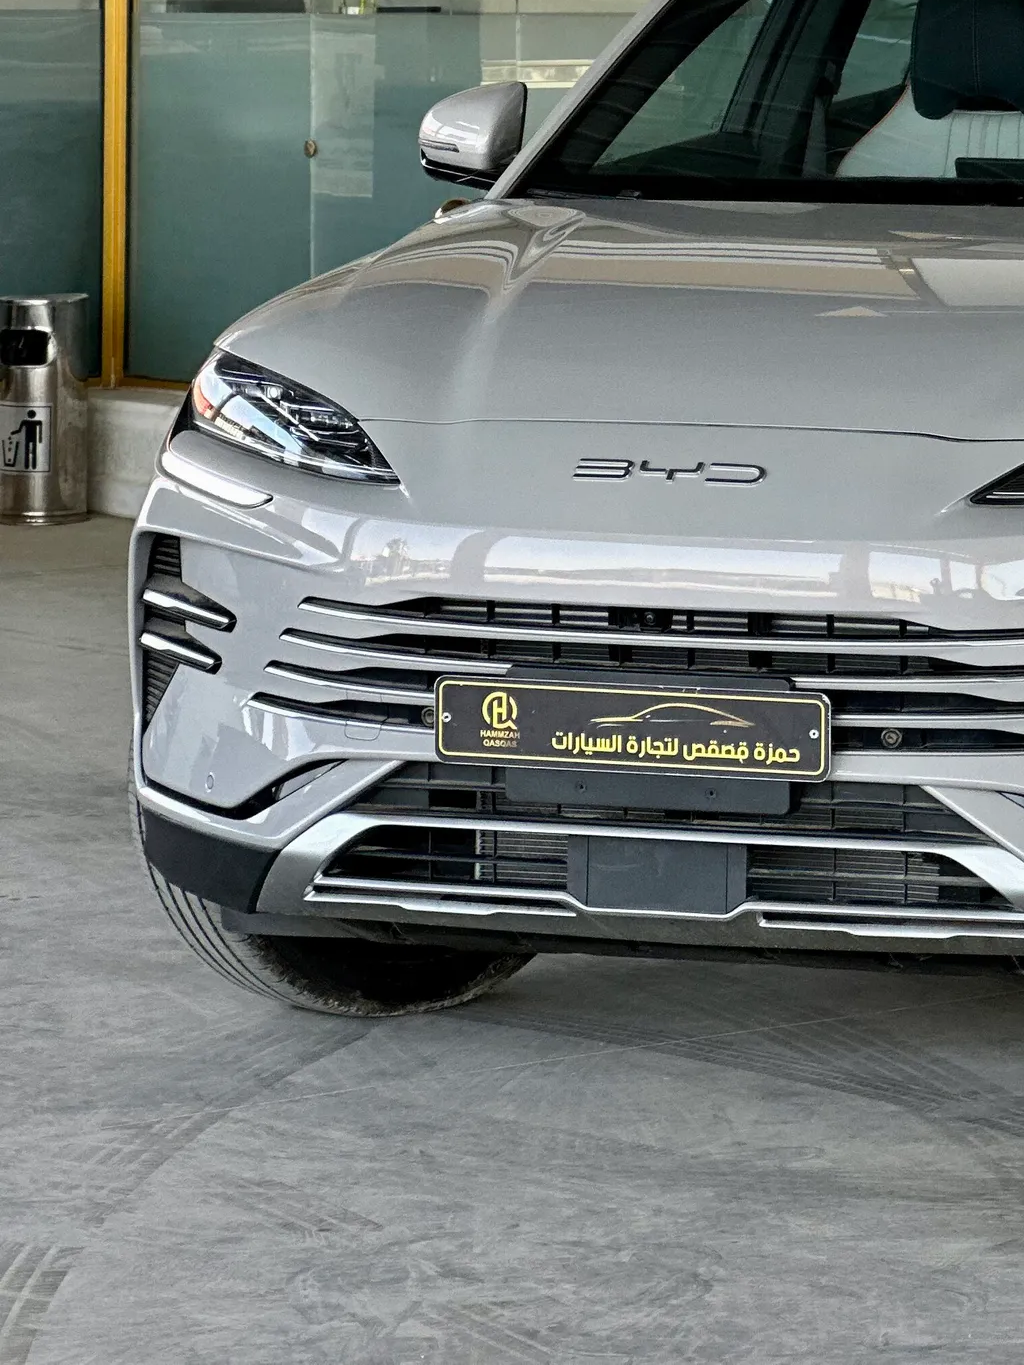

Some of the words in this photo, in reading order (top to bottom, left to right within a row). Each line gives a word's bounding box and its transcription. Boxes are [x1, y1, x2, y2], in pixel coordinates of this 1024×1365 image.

[572, 457, 767, 486] BYD
[480, 729, 520, 739] HAMMZAH
[482, 739, 518, 748] QASQAS
[551, 731, 623, 756] السيارات
[626, 735, 679, 758] لتجارة
[753, 741, 801, 765] حمزة
